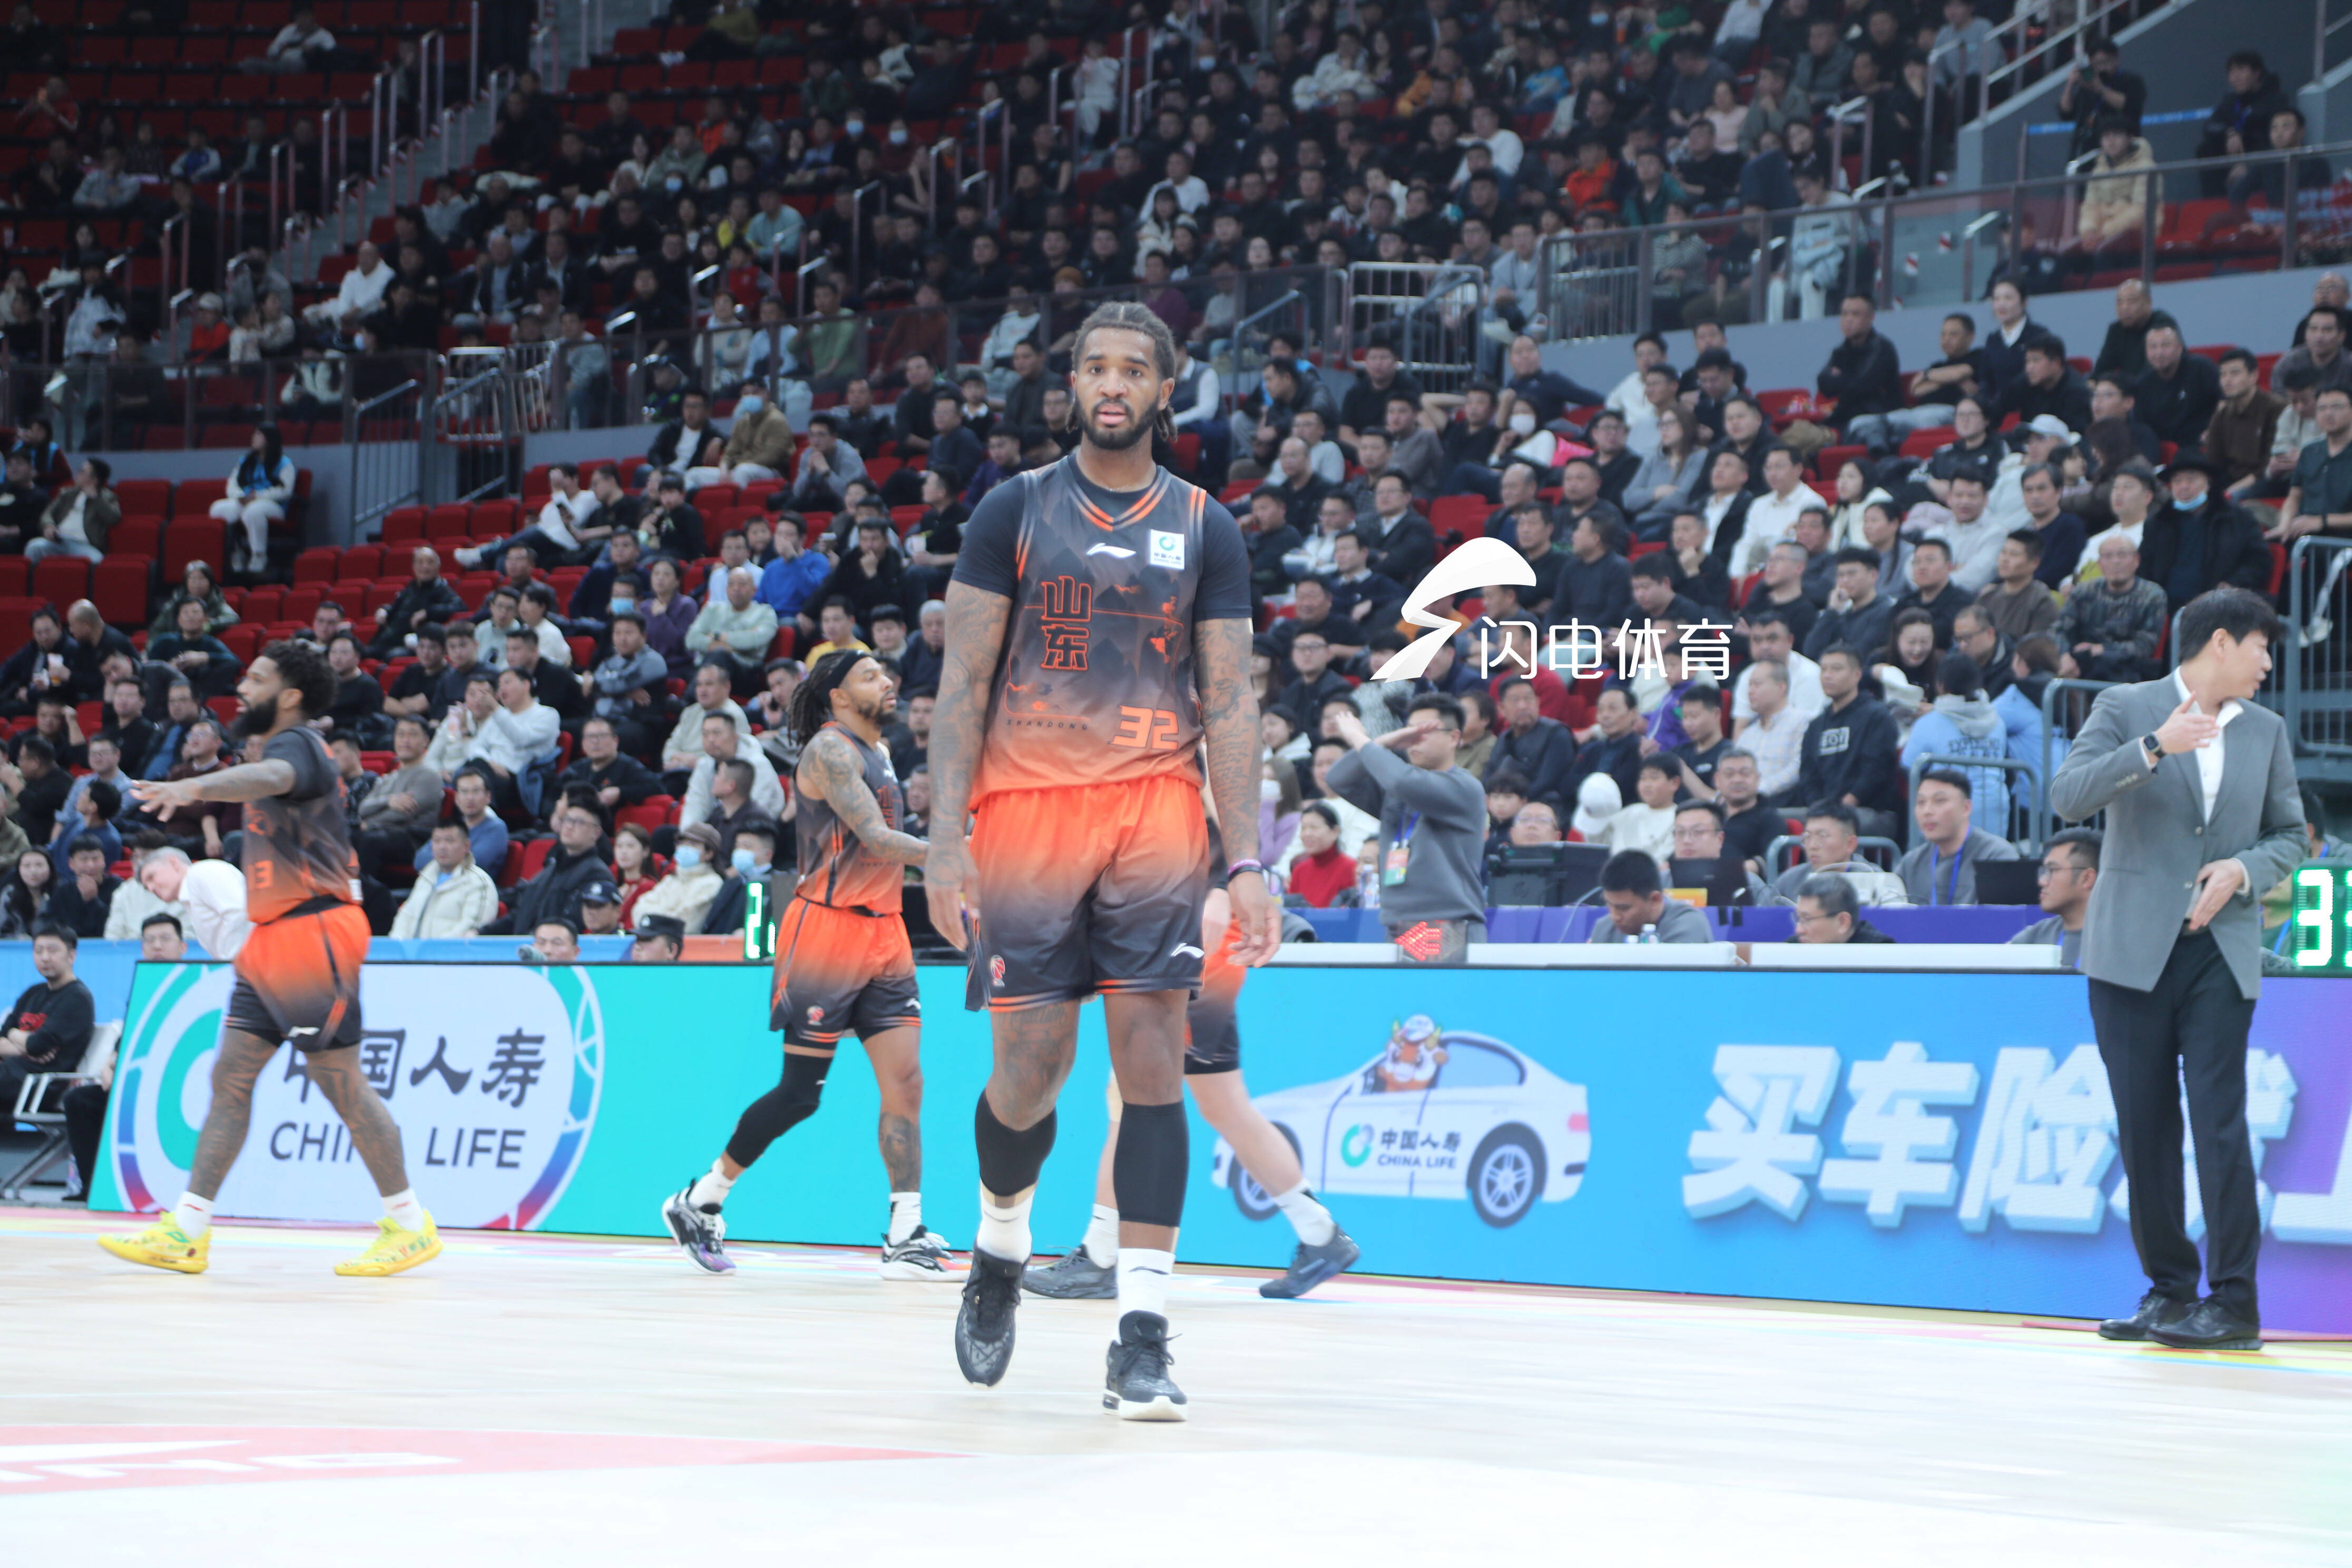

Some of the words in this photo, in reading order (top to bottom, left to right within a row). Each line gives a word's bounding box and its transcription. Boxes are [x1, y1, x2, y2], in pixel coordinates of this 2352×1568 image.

[1041, 575, 1092, 670] 山东
[1006, 719, 1088, 731] SHANDONG
[1108, 704, 1179, 750] 32
[425, 1126, 526, 1169] LIFE
[1378, 1153, 1422, 1167] CHINA
[1426, 1156, 1456, 1169] LIFE
